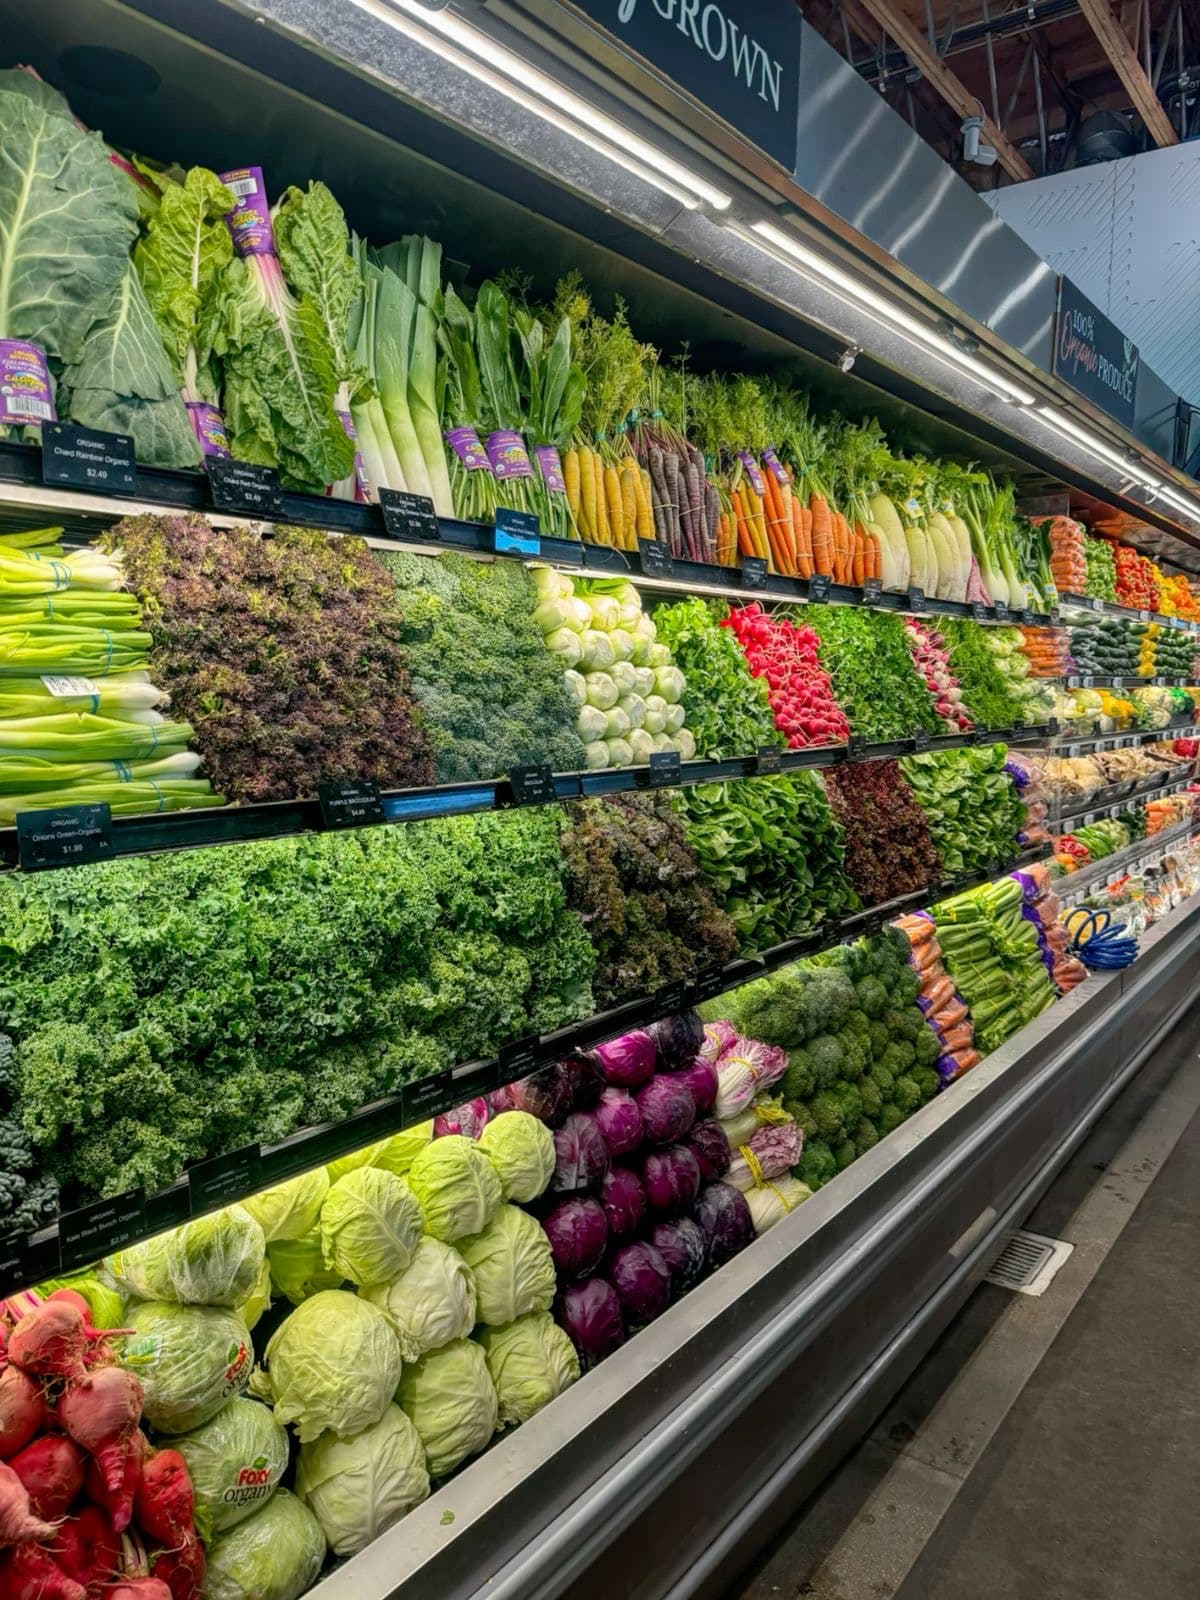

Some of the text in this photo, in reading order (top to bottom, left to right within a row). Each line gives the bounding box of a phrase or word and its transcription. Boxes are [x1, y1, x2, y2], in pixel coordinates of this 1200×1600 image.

[1073, 309, 1095, 342] 100%
[1060, 310, 1134, 404] Organic PRODUCE
[76, 439, 106, 450] ORGANIC
[54, 447, 130, 467] Chard Rainbow Organic
[51, 818, 80, 827] ORGANIC
[33, 833, 56, 842] Onions
